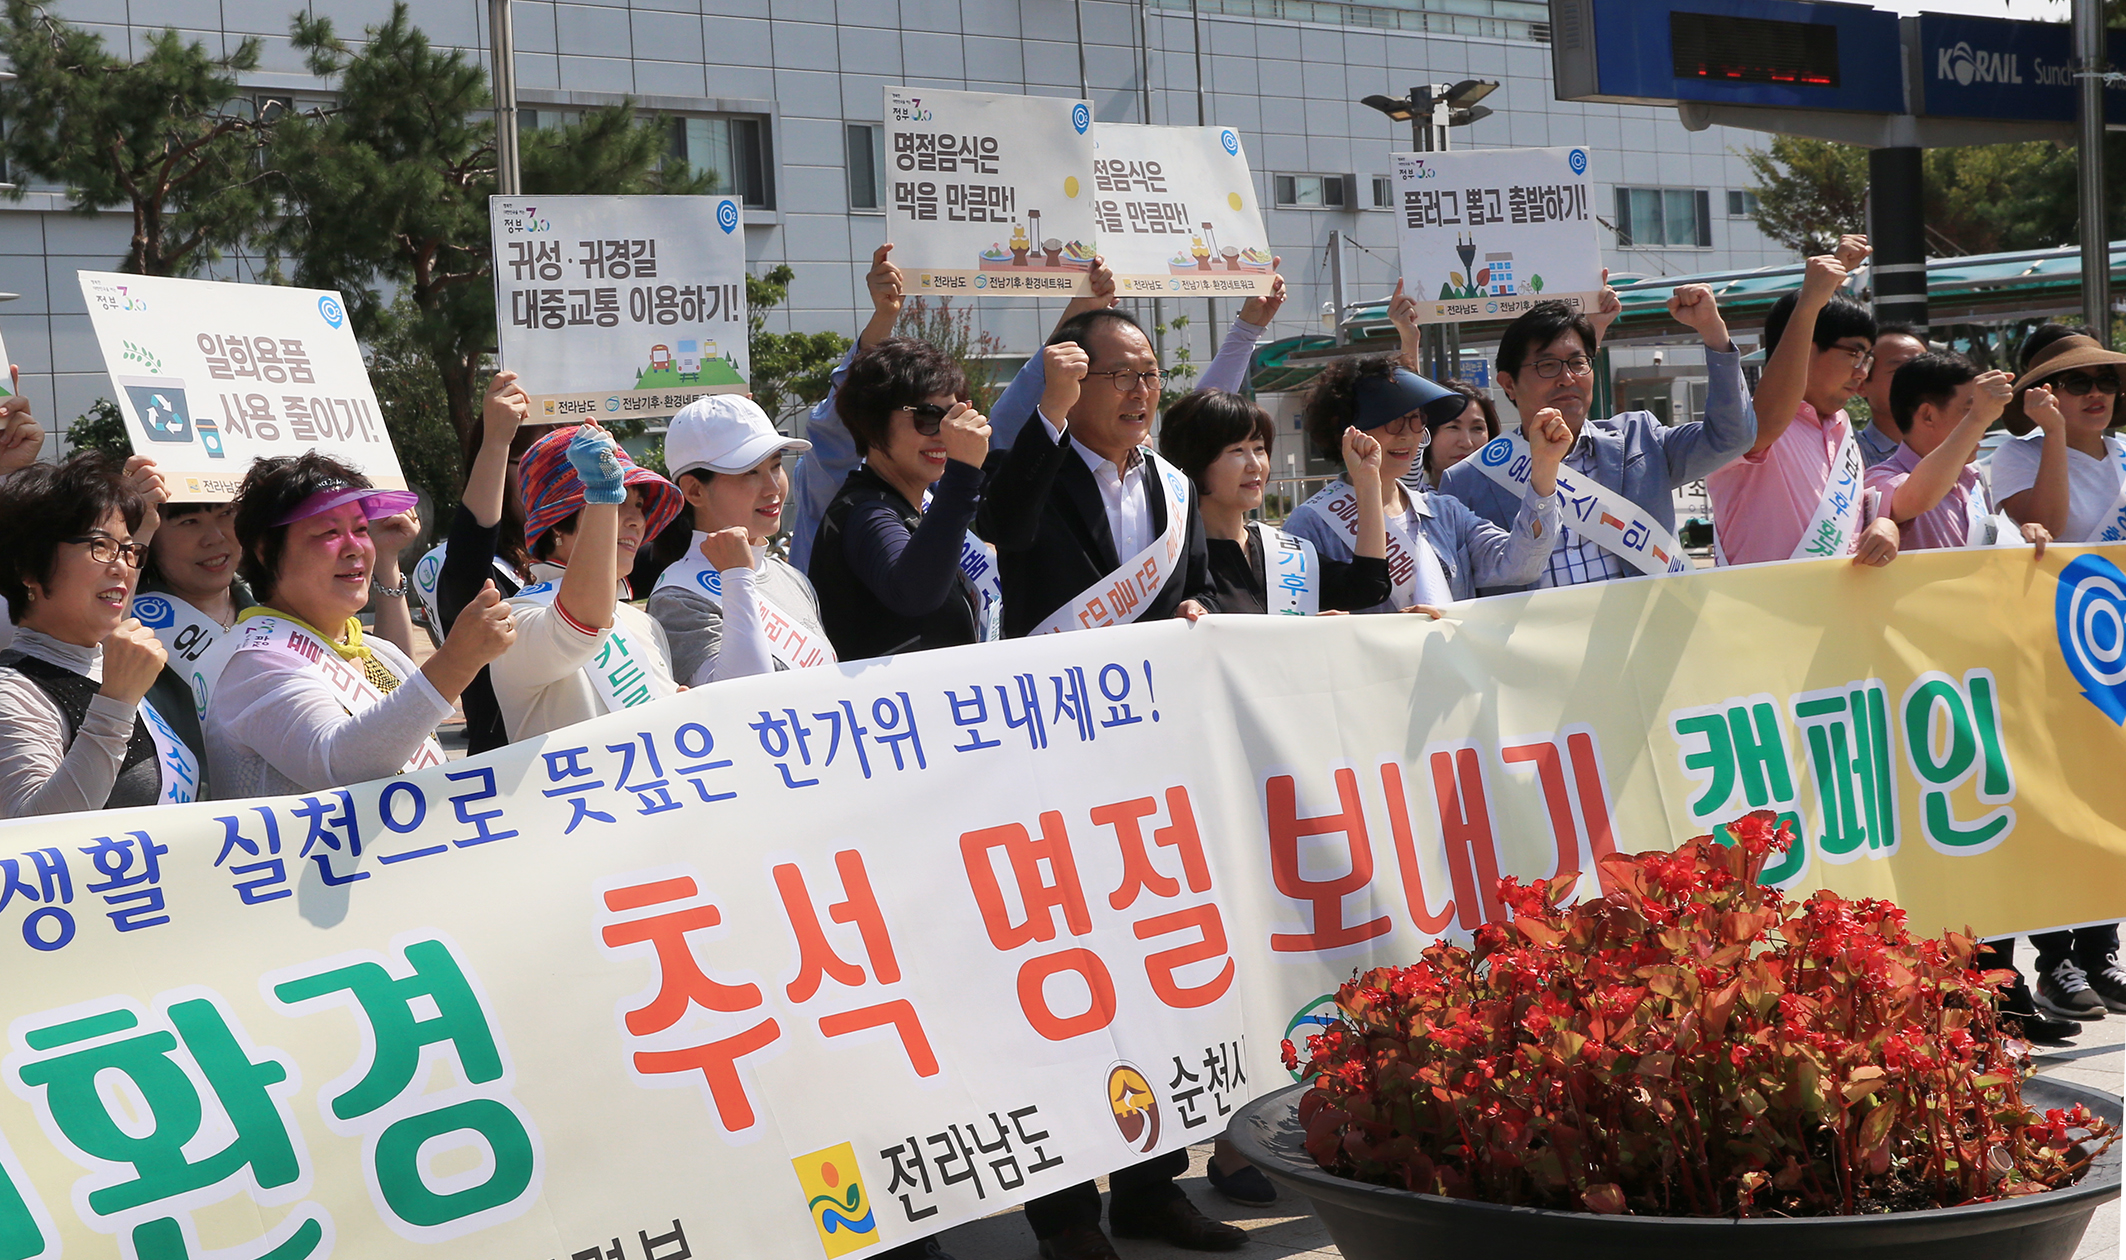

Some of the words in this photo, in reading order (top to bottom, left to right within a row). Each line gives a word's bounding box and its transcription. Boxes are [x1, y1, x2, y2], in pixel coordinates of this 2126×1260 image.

[1938, 41, 2023, 86] KORAIL
[894, 131, 1000, 175] 명절음식은
[1094, 159, 1167, 193] 절음식은
[895, 181, 938, 221] 먹을
[946, 183, 1016, 224] 만큼만!
[1125, 202, 1192, 234] 만큼만!
[1404, 190, 1461, 229] 플러그
[1466, 188, 1504, 226] 뽑고
[1508, 184, 1589, 224] 출발하기!
[504, 219, 524, 234] 정부
[934, 275, 967, 289] 전라남도
[989, 276, 1073, 290] 전남기후·환경네트워크
[1133, 279, 1163, 291] 전라남도
[511, 287, 620, 329] 대중교통
[629, 284, 739, 325] 이용하기!
[1447, 304, 1479, 316] 전라남도
[197, 333, 316, 384] 일회용품
[219, 392, 281, 441] 사용
[282, 396, 380, 443] 줄이기!
[558, 399, 596, 414] 전라남도
[622, 393, 718, 411] 전남기후·환경네
[1508, 454, 1598, 523] 온가스
[0, 830, 170, 951] 생활
[213, 769, 519, 905] 실천으로
[541, 721, 737, 836] 뜻깊은
[749, 691, 927, 790] 한가위
[944, 659, 1162, 754] 보내세요!
[0, 939, 534, 1260] 환경
[601, 848, 941, 1134] 추석
[958, 784, 1236, 1043] 명절
[1264, 731, 1617, 953] 보내기
[1674, 676, 2009, 886] 캠페인
[880, 1104, 1064, 1223] 전라남도
